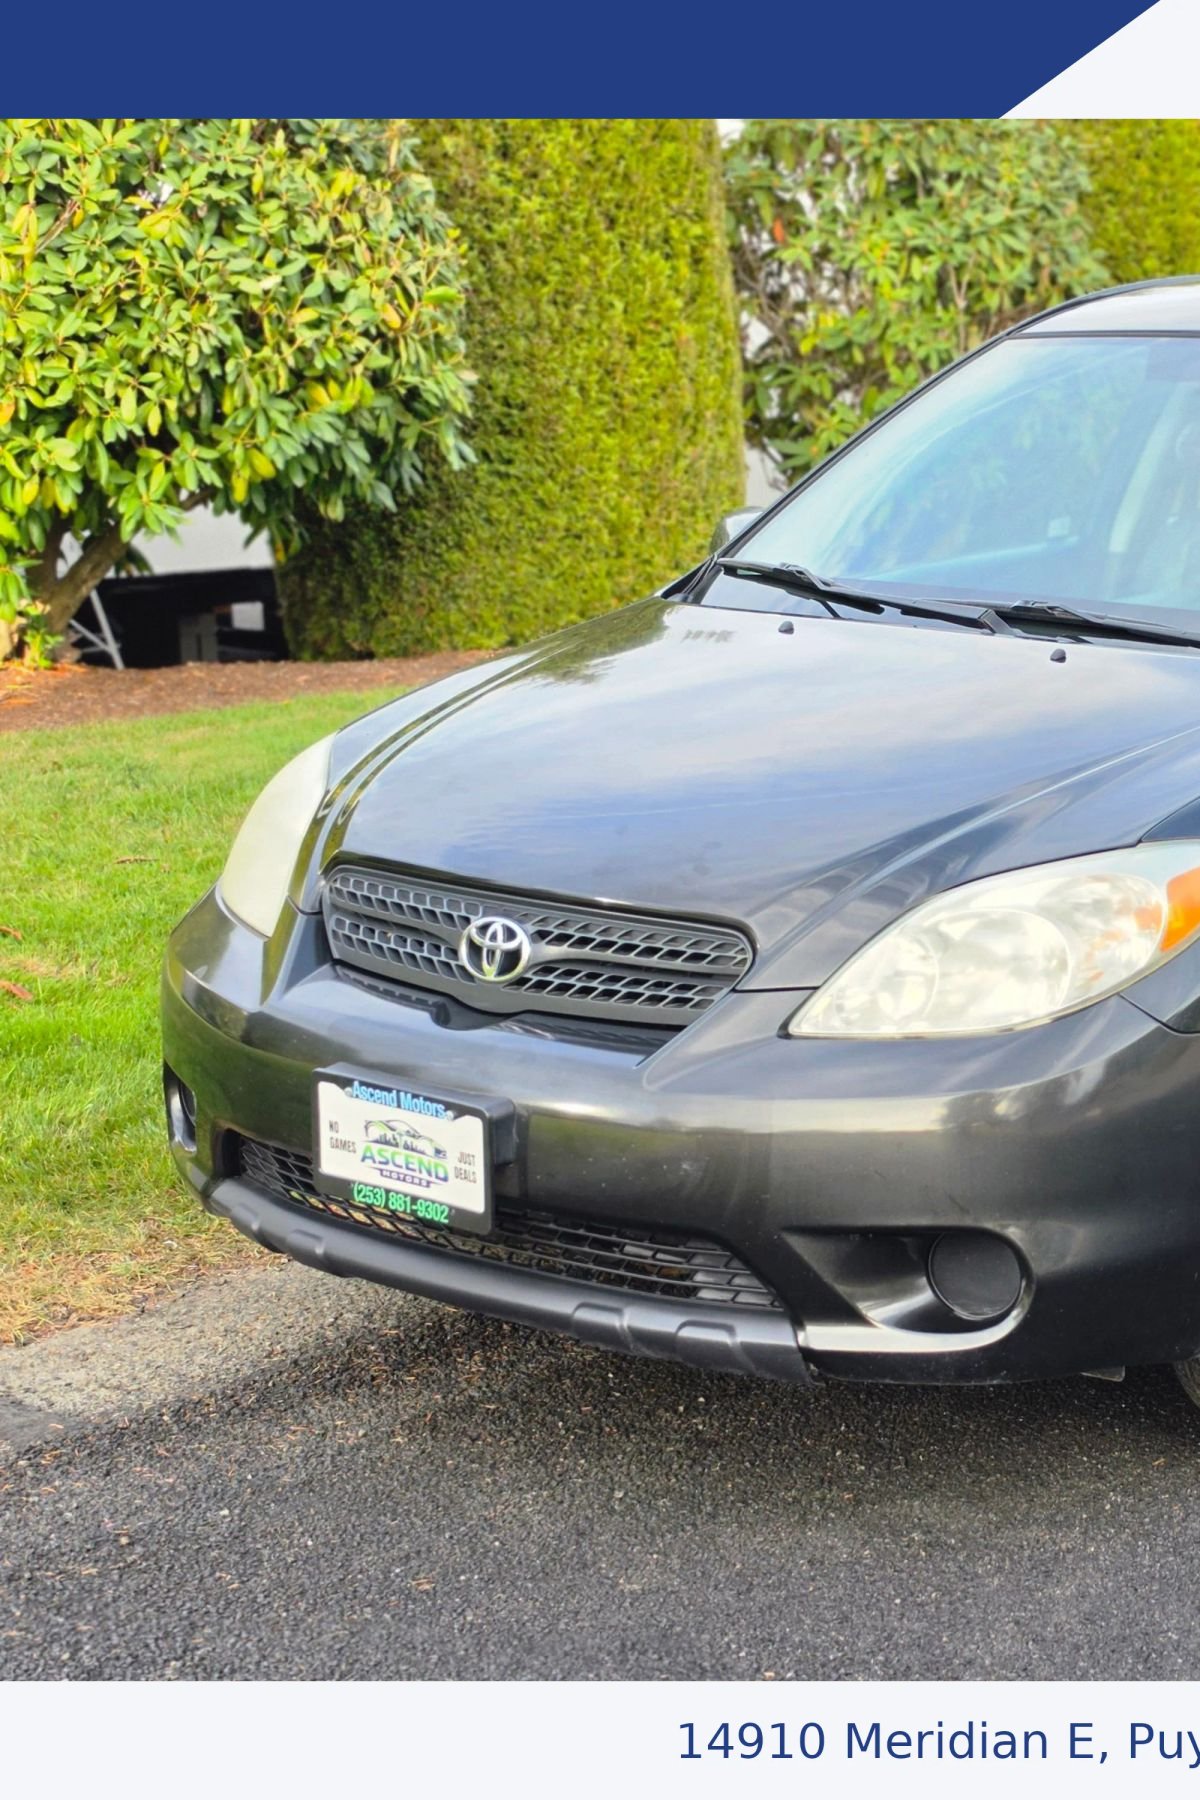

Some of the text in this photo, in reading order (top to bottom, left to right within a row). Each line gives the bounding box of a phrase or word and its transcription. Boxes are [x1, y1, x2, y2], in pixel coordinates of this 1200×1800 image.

[352, 1081, 445, 1119] Ascend Motors
[328, 1120, 340, 1133] NO
[330, 1136, 357, 1154] GAMES
[360, 1144, 449, 1183] ASCEND
[457, 1151, 476, 1166] JUST
[382, 1169, 428, 1187] MOTORS
[454, 1166, 478, 1184] DEALS
[353, 1182, 449, 1223] (253) 881-9302
